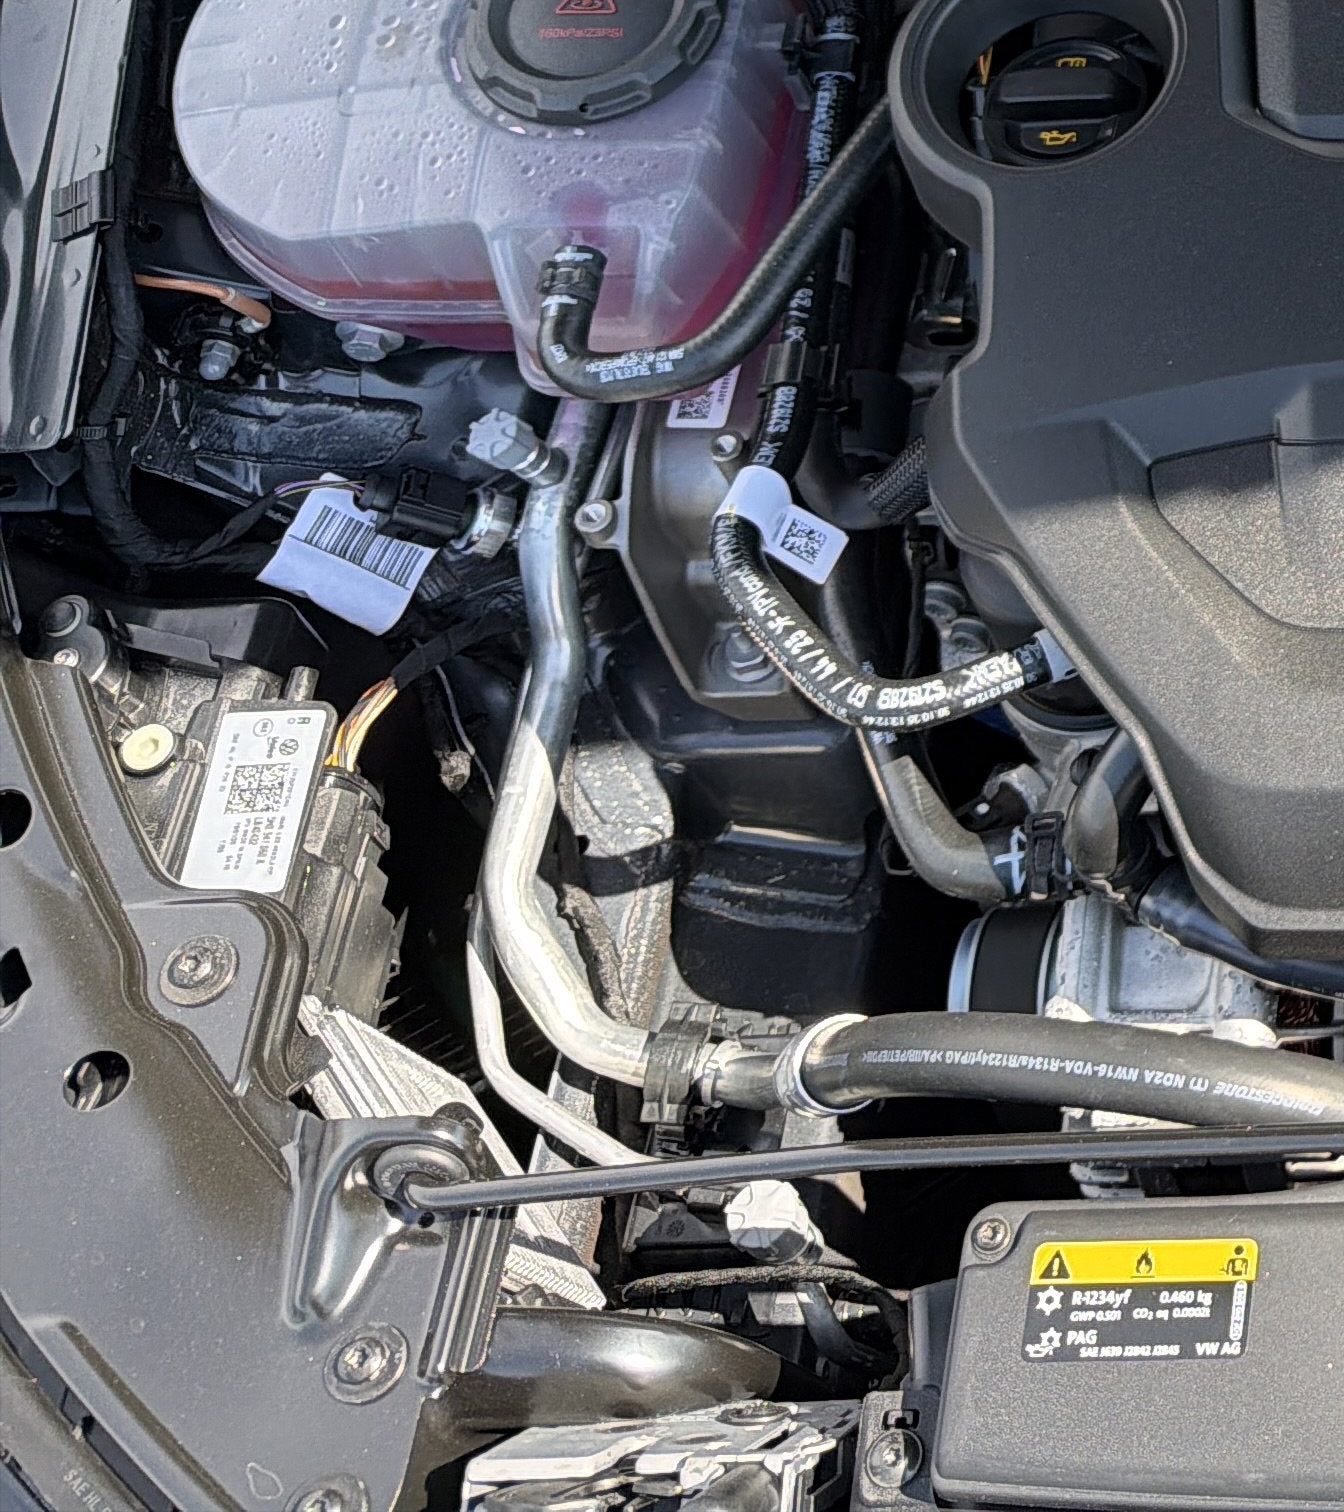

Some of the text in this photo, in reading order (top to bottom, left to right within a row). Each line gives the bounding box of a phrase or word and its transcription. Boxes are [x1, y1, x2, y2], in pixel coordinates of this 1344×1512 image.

[1071, 1289, 1213, 1308] R-1234yf 0.460 kg
[1067, 1330, 1098, 1345] PAG
[1195, 1342, 1219, 1356] VW
[1220, 1341, 1241, 1354] AG
[63, 1469, 83, 1496] SAE
